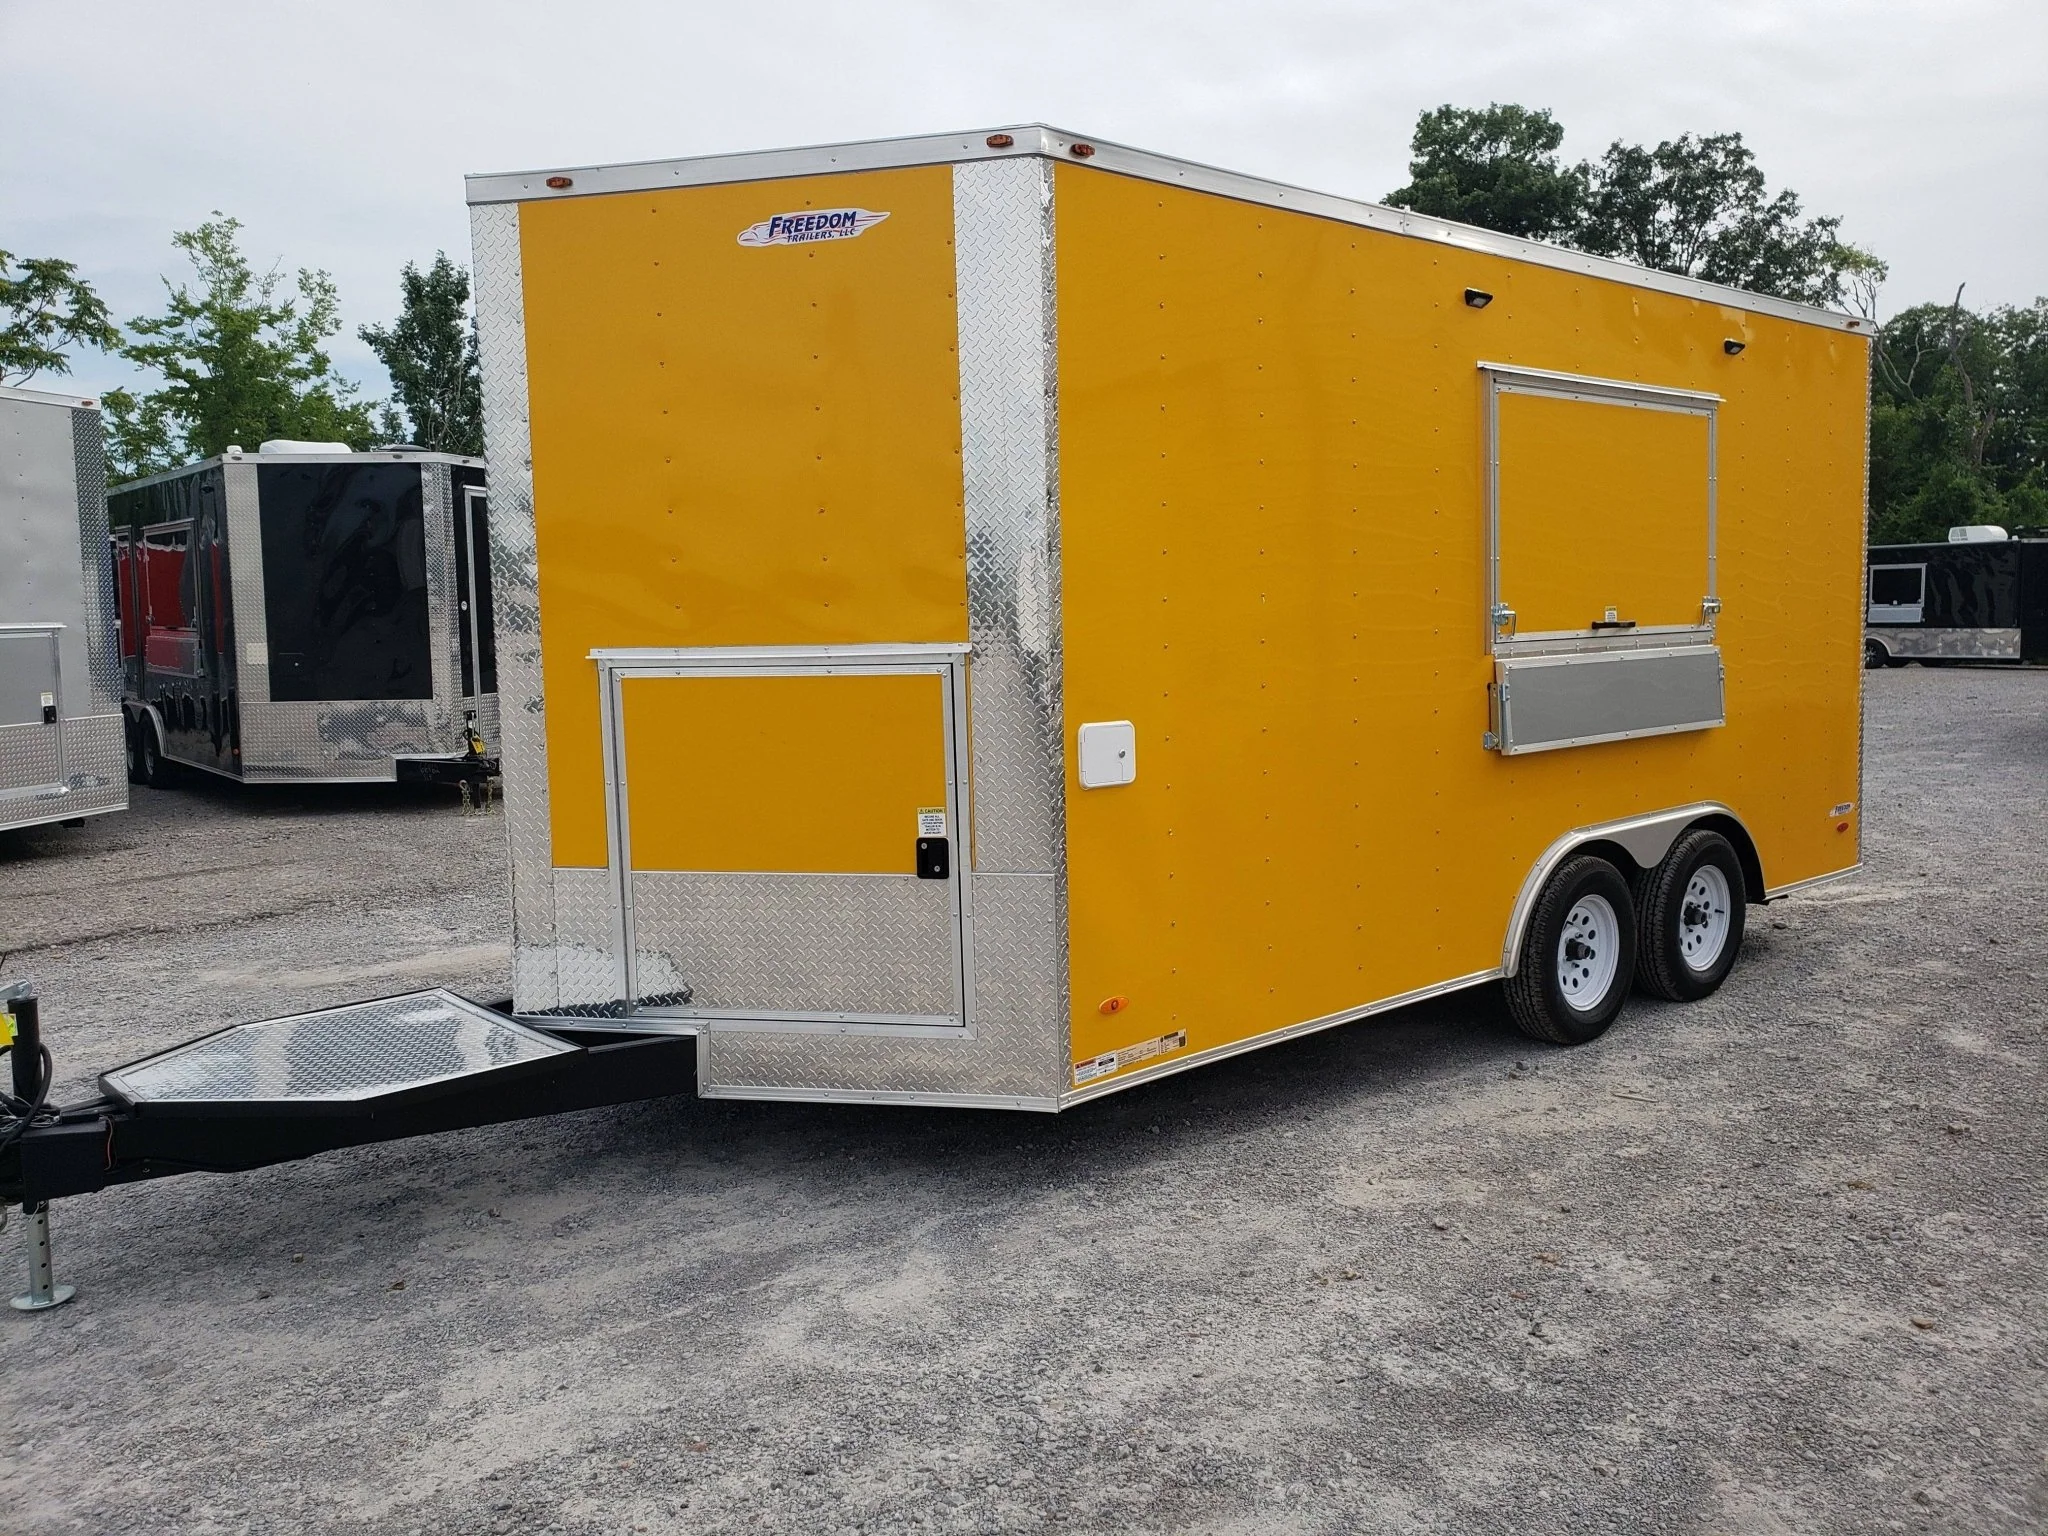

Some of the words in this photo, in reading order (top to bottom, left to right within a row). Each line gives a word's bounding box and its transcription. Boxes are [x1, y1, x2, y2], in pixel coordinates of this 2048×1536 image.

[769, 211, 857, 238] FREEDOM
[787, 230, 835, 243] TRAILERS,
[839, 228, 856, 237] LLC
